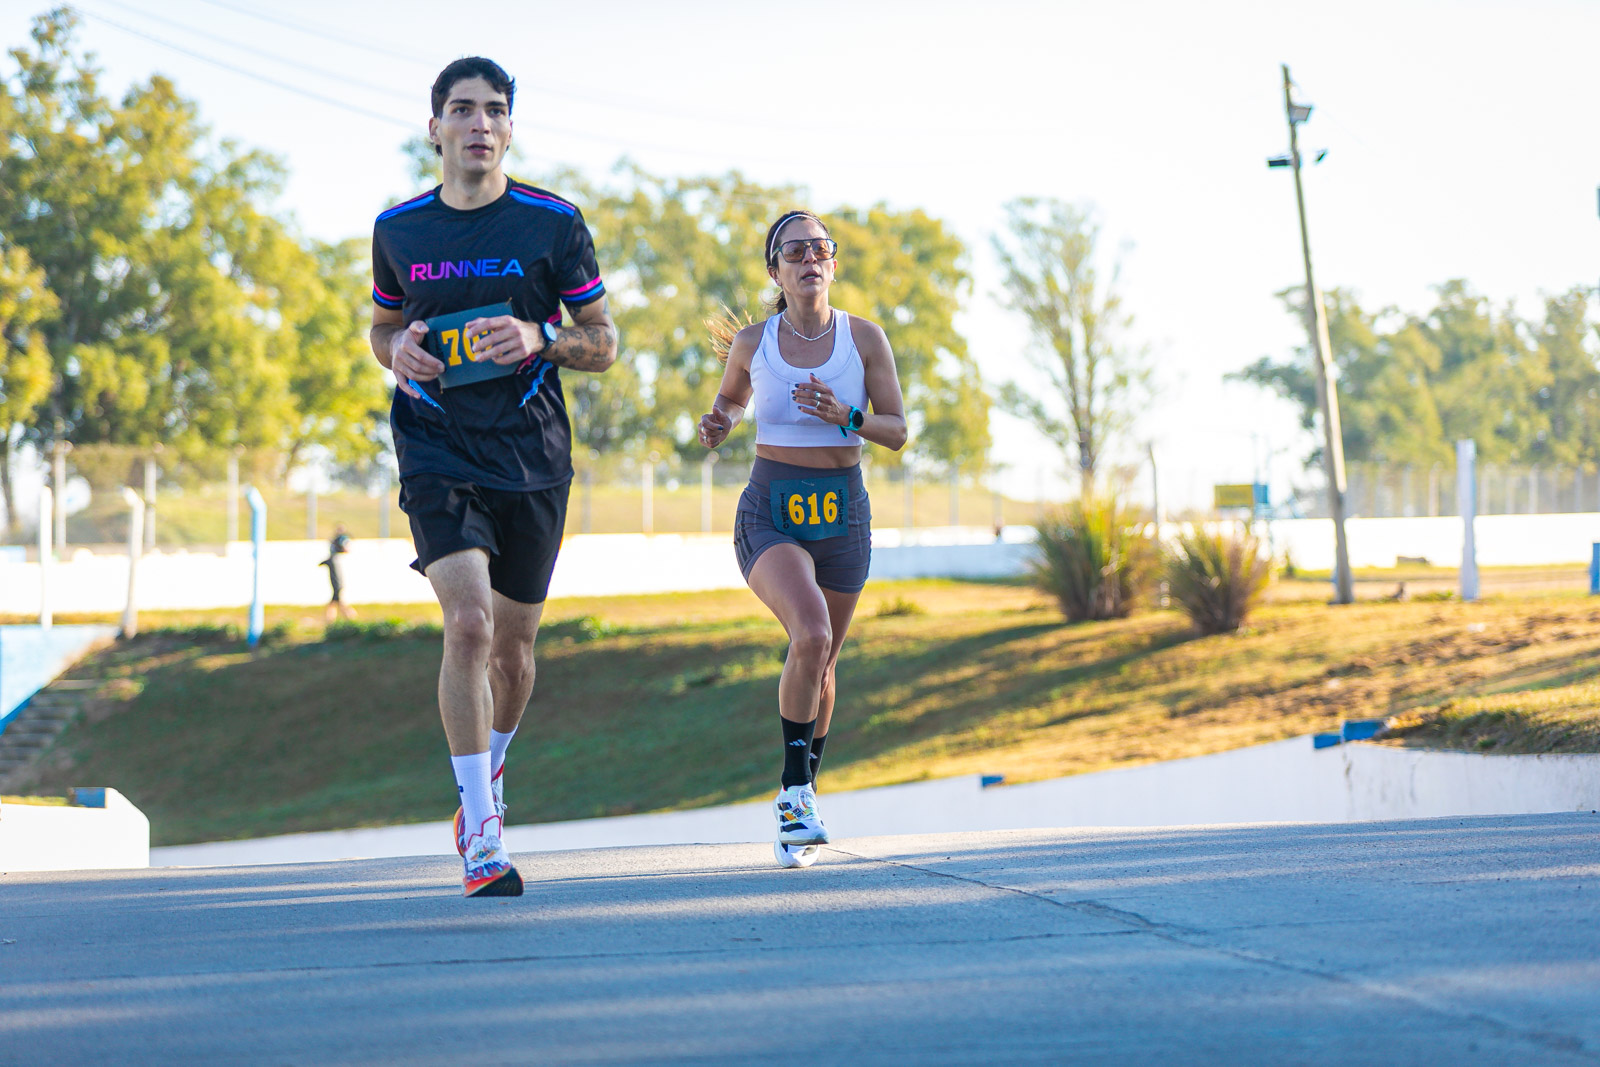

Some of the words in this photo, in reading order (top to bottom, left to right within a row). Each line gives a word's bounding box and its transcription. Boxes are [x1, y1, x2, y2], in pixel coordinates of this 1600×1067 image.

[410, 258, 525, 282] RUNNEA
[441, 328, 504, 366] 70
[780, 493, 789, 529] TIEMPO
[788, 491, 838, 525] 616
